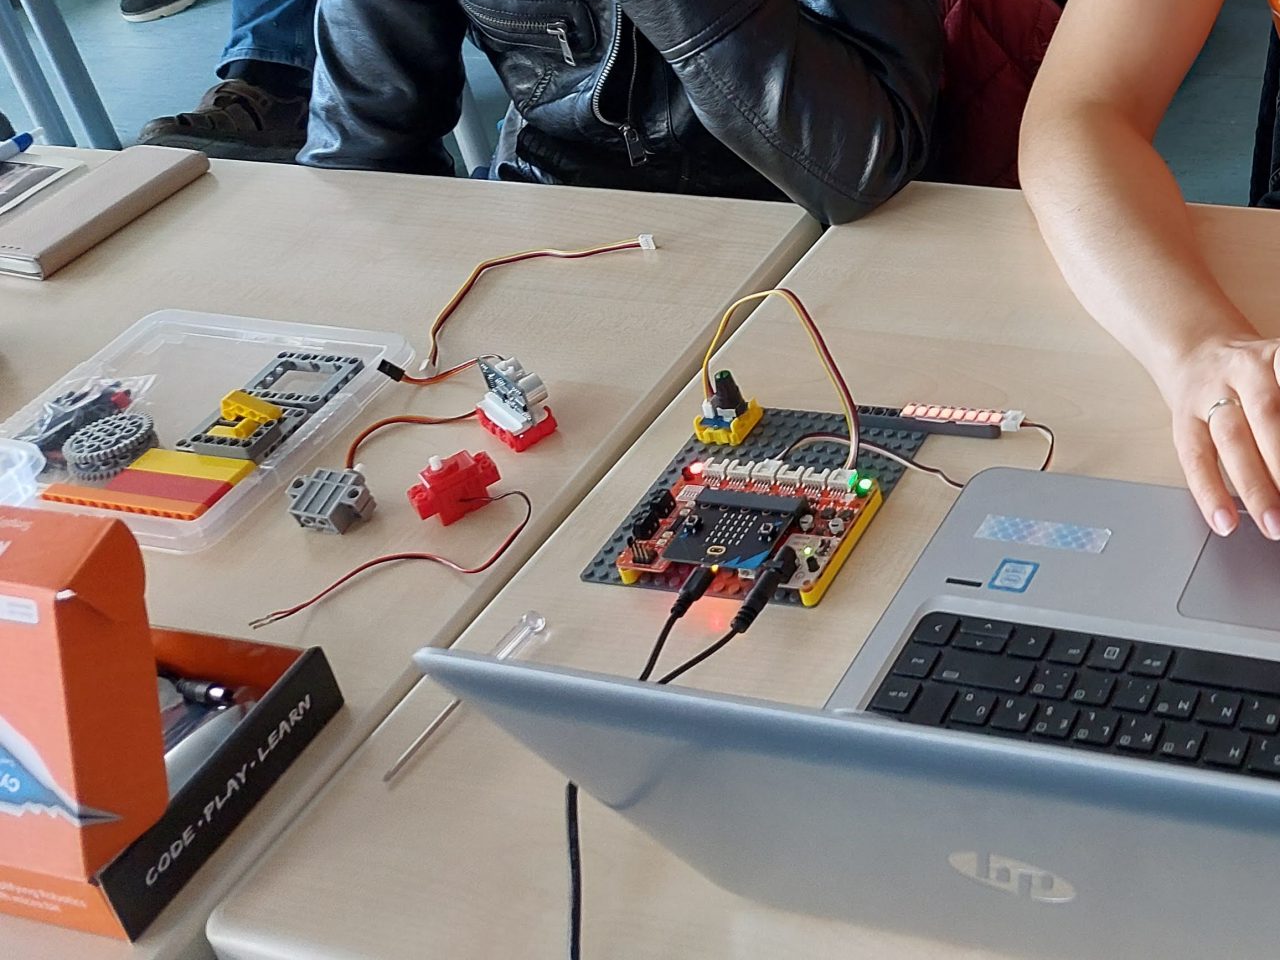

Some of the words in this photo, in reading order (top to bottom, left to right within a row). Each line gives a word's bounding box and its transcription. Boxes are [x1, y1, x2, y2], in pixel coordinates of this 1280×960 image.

[145, 824, 196, 886] CODE
[203, 763, 248, 822] PLAY
[257, 694, 311, 763] LEARN
